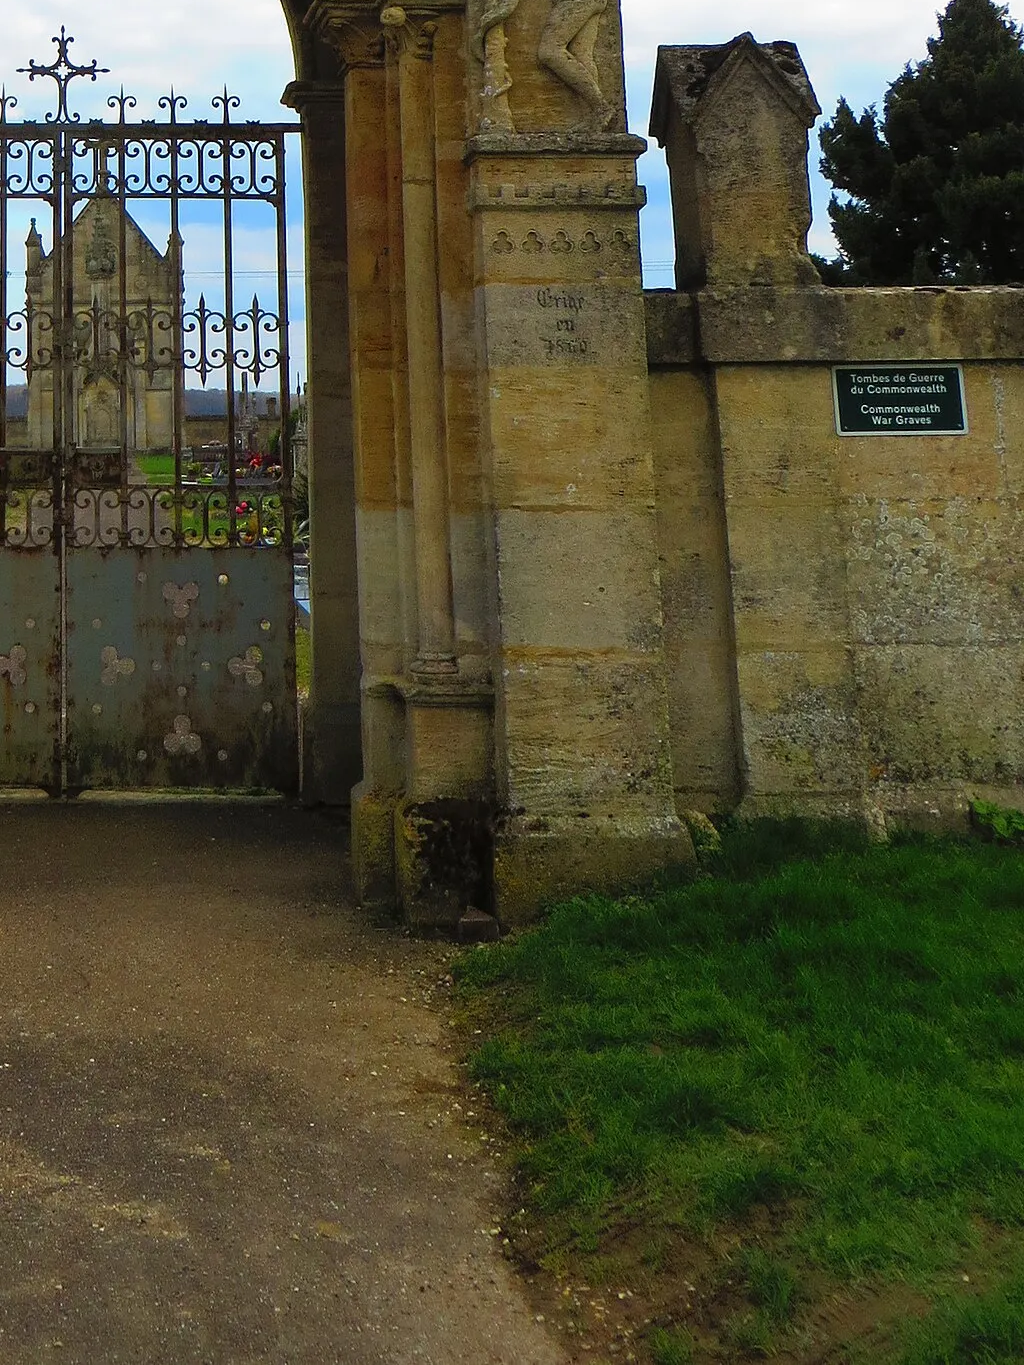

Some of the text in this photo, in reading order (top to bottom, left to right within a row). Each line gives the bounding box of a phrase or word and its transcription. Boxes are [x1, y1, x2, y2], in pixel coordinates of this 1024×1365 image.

[556, 319, 575, 332] en
[850, 373, 945, 383] Tombes de Guerre
[850, 383, 947, 394] du Commonwealth
[860, 403, 941, 414] Commonwealth
[871, 415, 932, 425] War Graves
